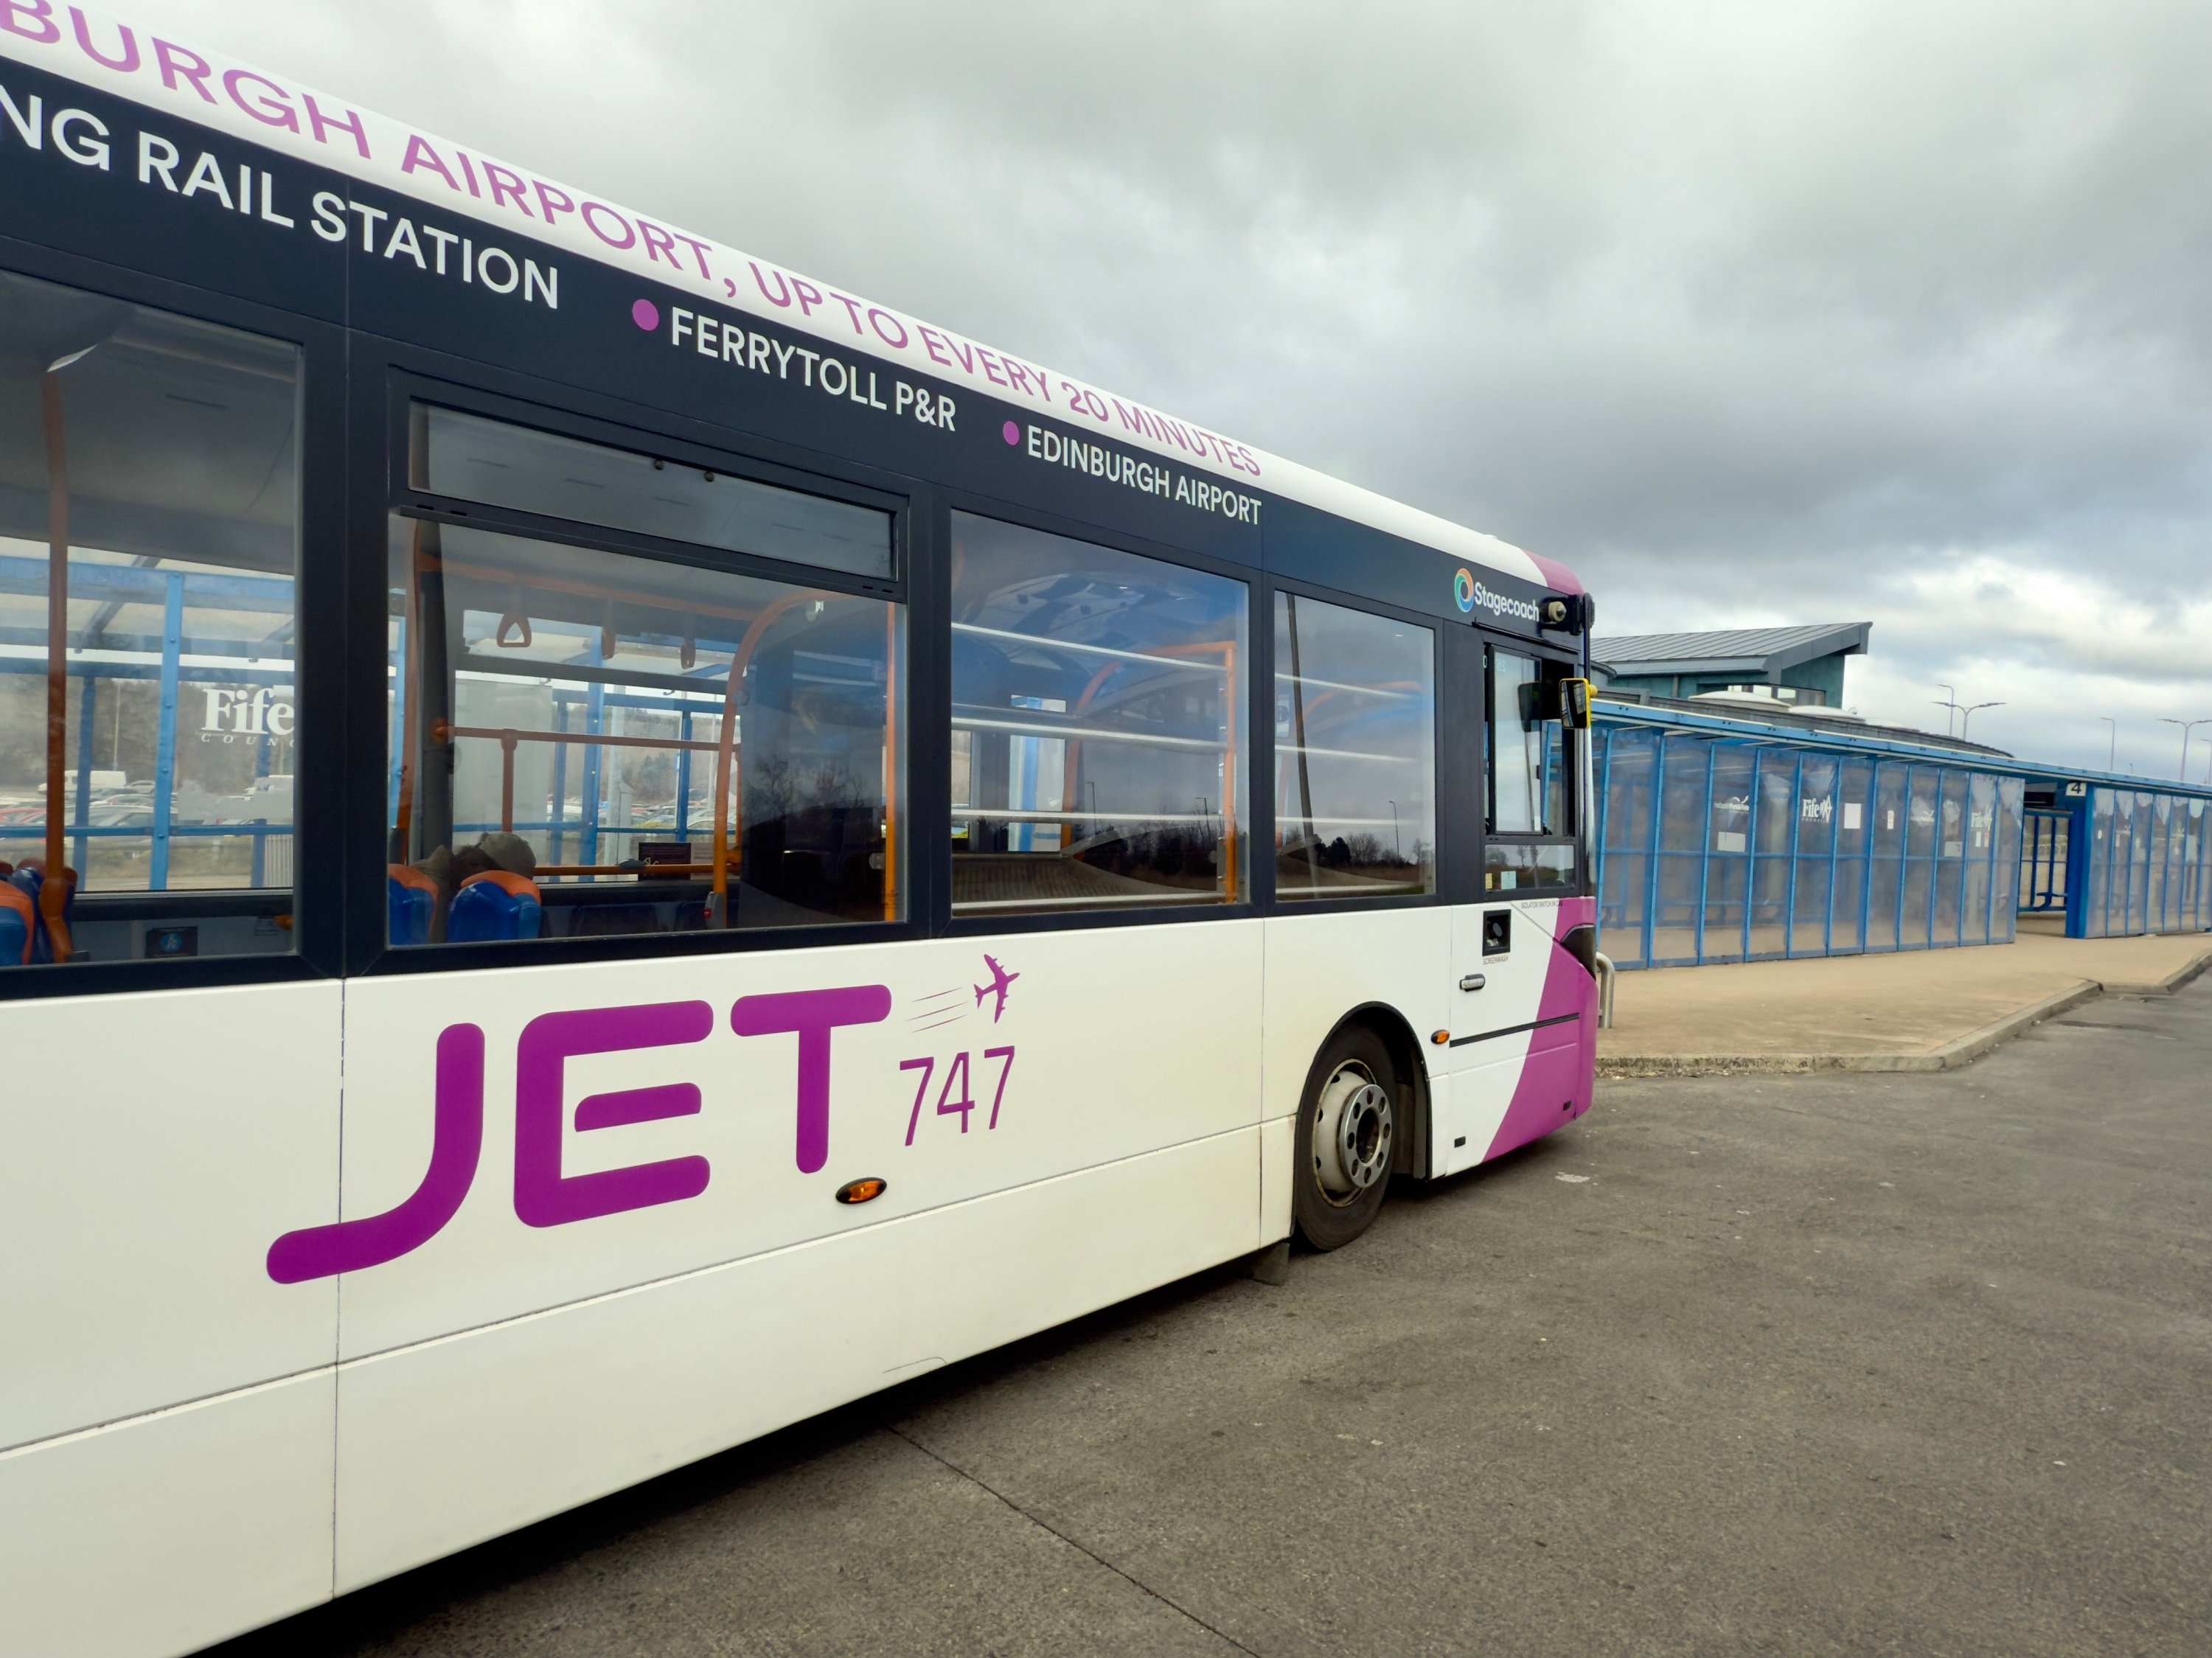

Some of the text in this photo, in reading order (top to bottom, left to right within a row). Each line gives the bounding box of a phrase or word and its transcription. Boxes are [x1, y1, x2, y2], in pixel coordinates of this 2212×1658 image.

[139, 130, 294, 229] RAIL
[310, 191, 557, 310] STATION
[672, 307, 956, 432] FERRYTOLL P&R
[748, 262, 824, 317] UP
[830, 289, 908, 349] TO
[917, 326, 1056, 403] EVERY
[1060, 381, 1110, 422] 20
[1112, 398, 1262, 477] MINUTES
[1028, 425, 1262, 526] EDINBURGH AIRPORT
[1475, 581, 1540, 622] Stagecoach
[201, 687, 294, 736] Fife
[1802, 798, 1820, 818] Fife
[2070, 781, 2081, 794] 4
[266, 984, 1015, 1285] JET 747
